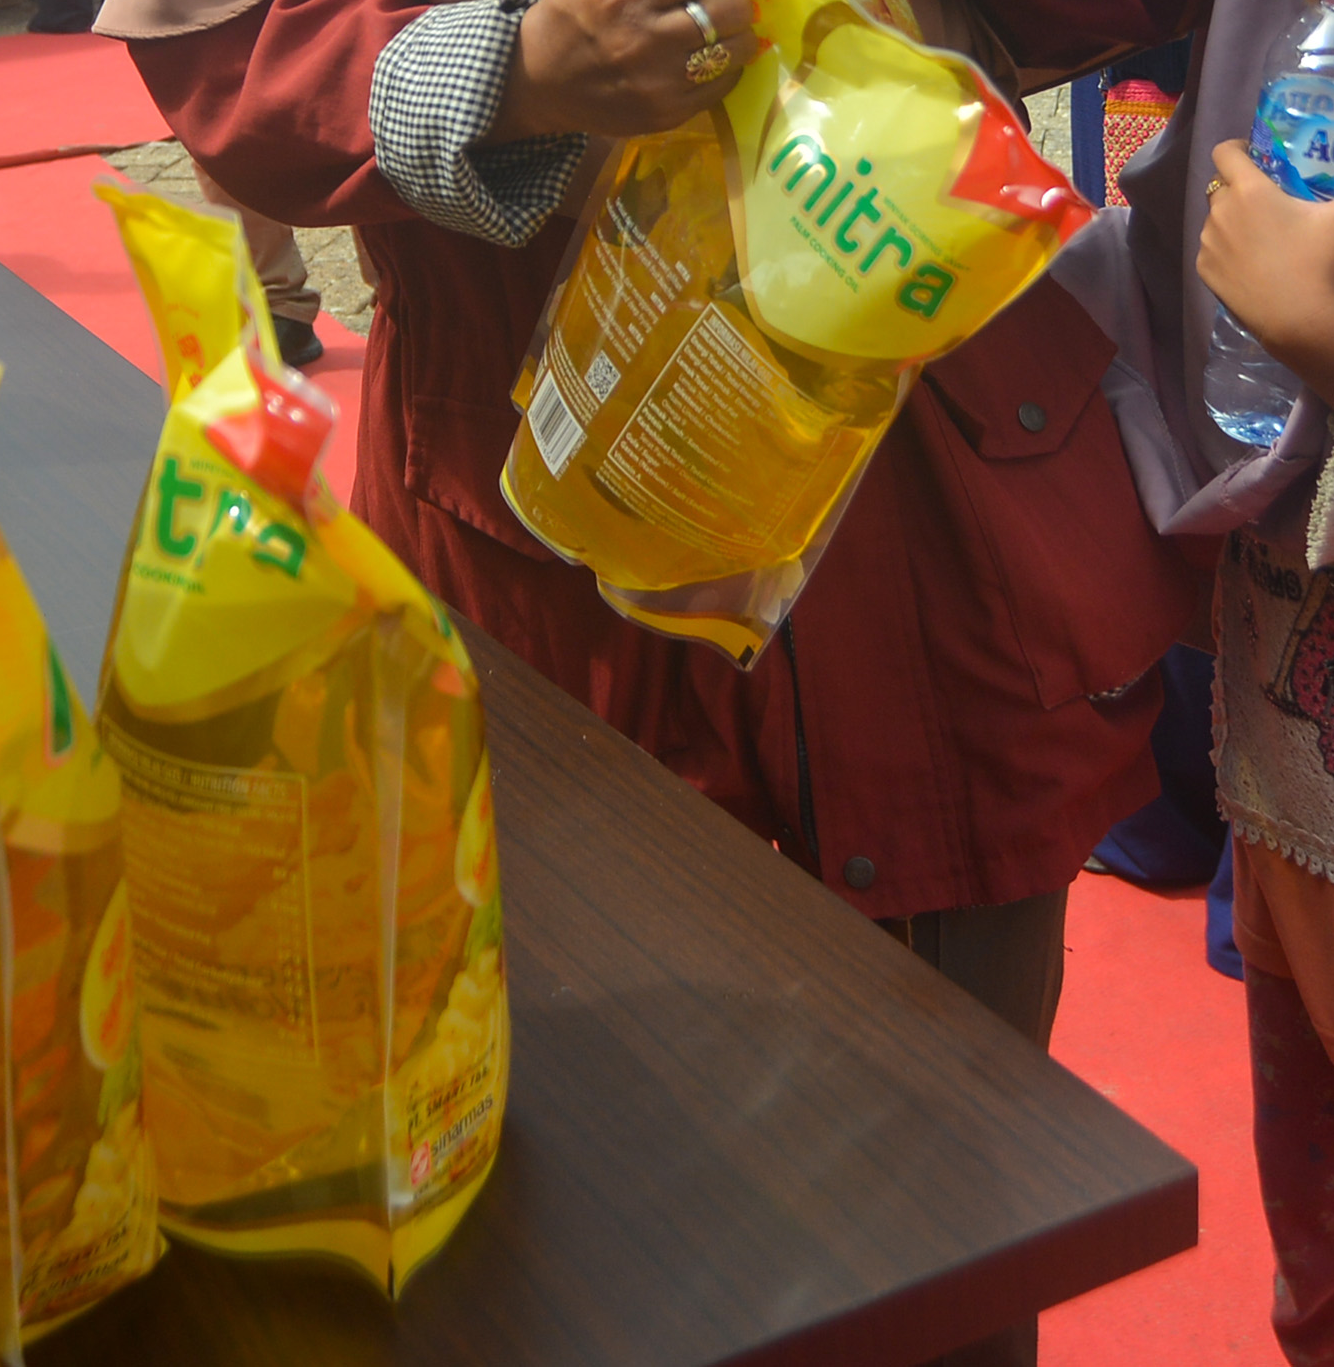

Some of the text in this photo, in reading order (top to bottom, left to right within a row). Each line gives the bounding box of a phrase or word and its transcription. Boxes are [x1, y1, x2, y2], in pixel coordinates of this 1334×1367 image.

[766, 133, 959, 321] mitra
[787, 215, 862, 294] PALM COOKING OIL
[688, 333, 710, 359] Energi
[707, 353, 723, 372] Total
[724, 371, 741, 389] Total
[706, 314, 742, 355] INFORMASI
[737, 347, 759, 371] NILAI
[675, 354, 696, 378] Lemak
[692, 373, 710, 393] Total
[711, 392, 728, 410] Total
[682, 343, 703, 367] Energi
[709, 373, 731, 396] Lemak
[641, 405, 664, 431] Protein
[659, 397, 682, 423] Omega
[672, 380, 703, 414] Kolesterol
[624, 430, 661, 470] Gula Sugar
[646, 396, 668, 421] Lemak
[686, 436, 720, 467] Saturated
[668, 447, 685, 465] Total
[612, 449, 637, 476] Vitamin
[618, 439, 640, 464] Garam
[637, 458, 670, 490] (Natrium)
[432, 1092, 494, 1157] sinarmas
